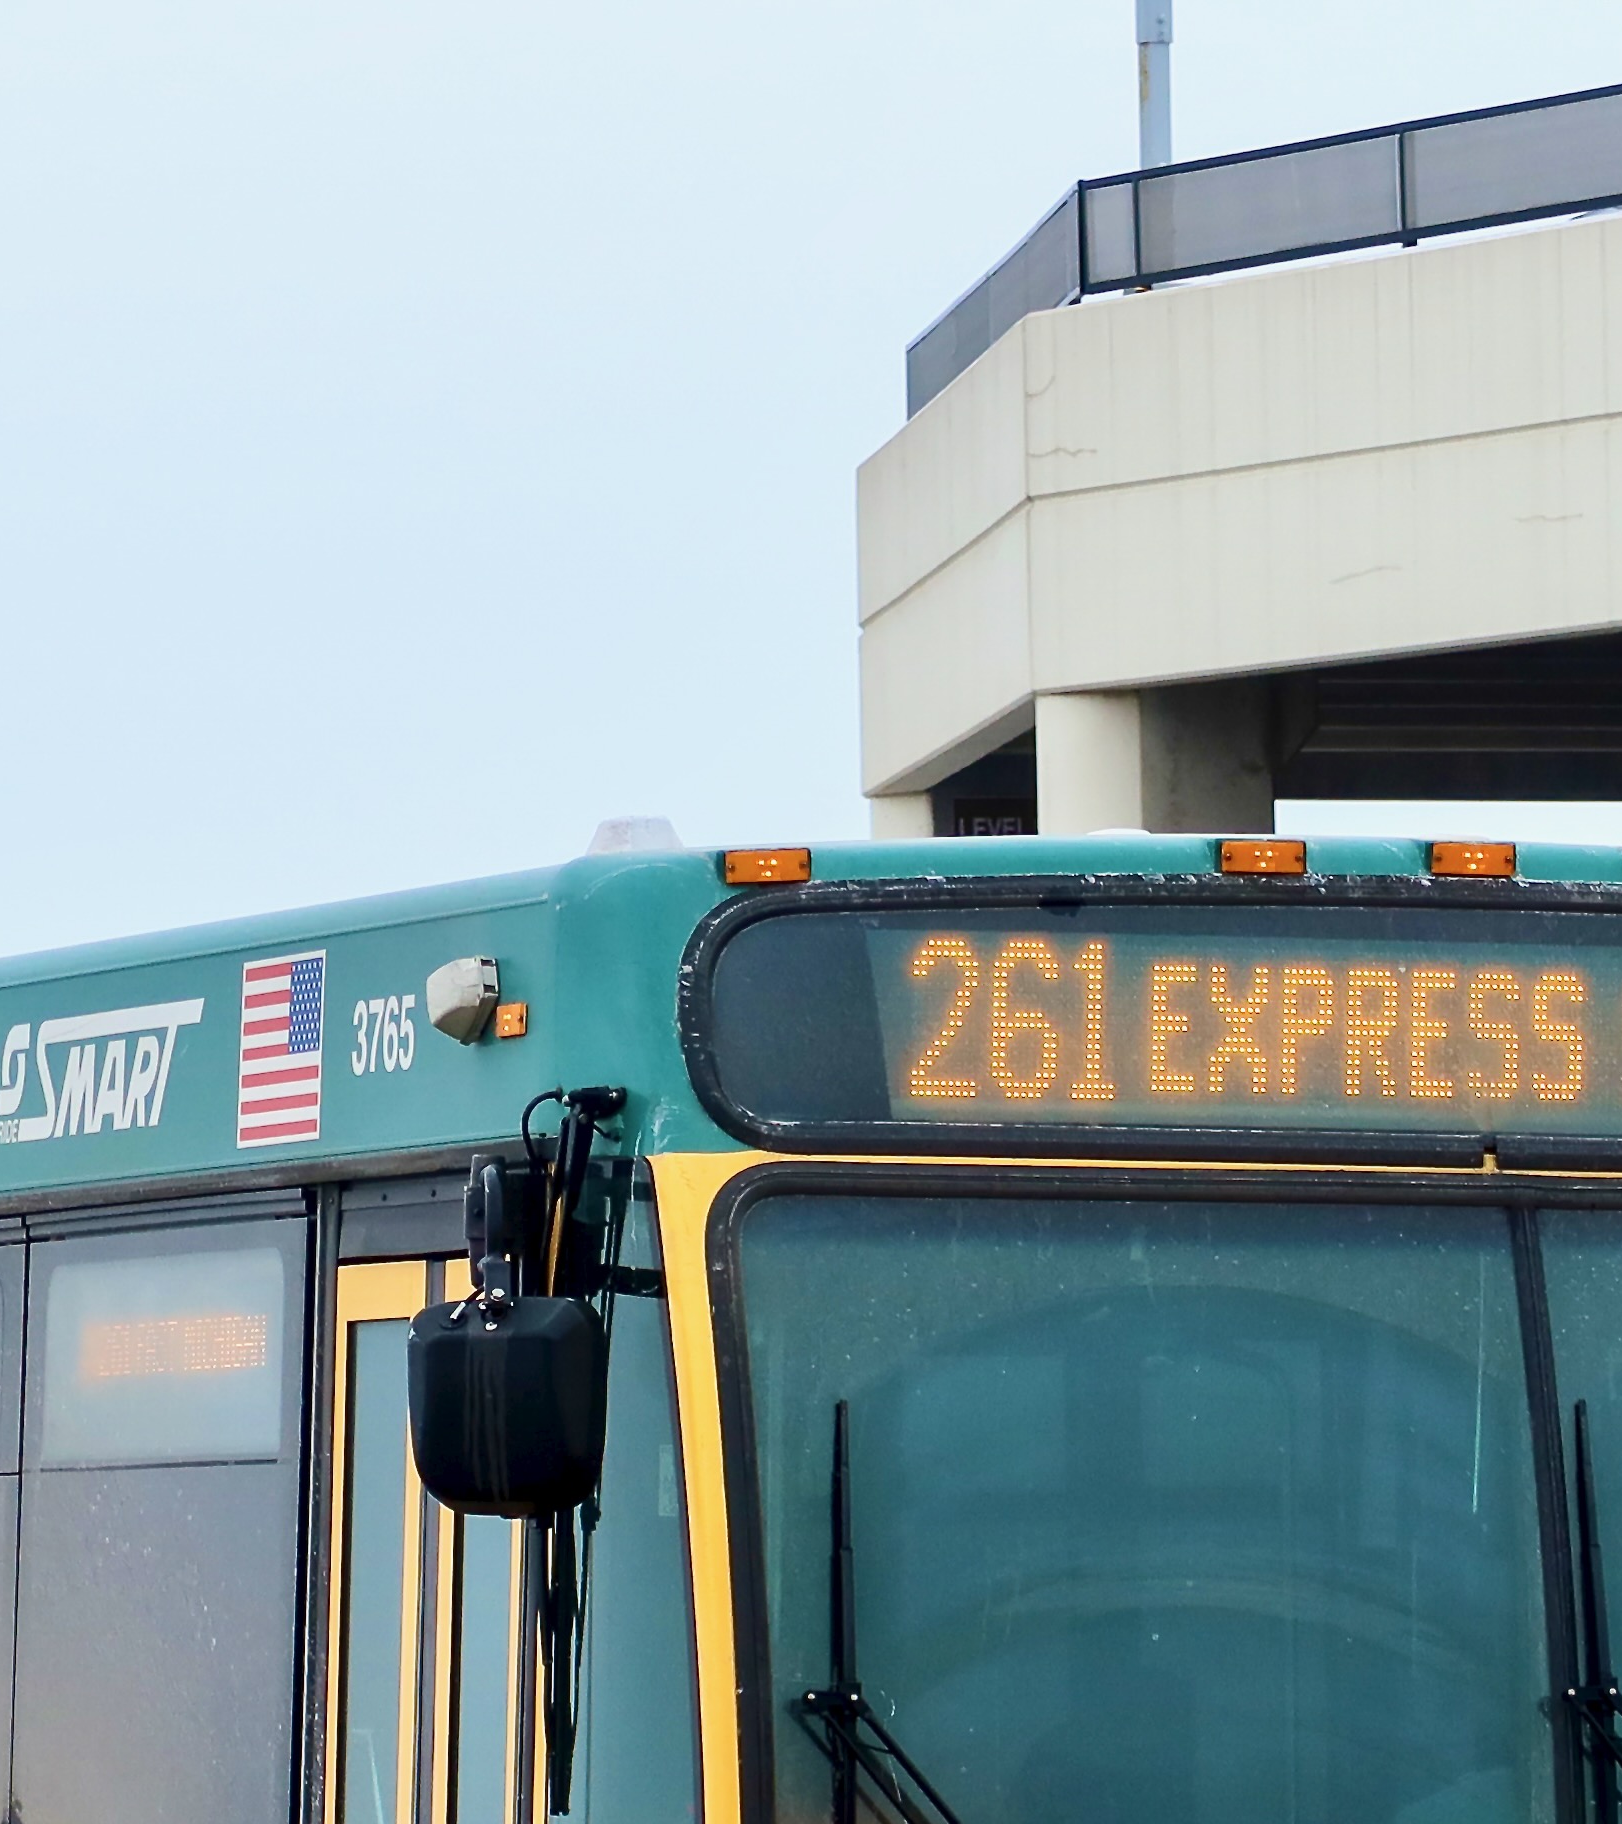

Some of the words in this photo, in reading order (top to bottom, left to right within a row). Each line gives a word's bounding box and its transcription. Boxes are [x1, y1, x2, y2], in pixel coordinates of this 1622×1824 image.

[19, 998, 205, 1143] SMART
[351, 994, 416, 1077] 3765
[910, 938, 1115, 1100] 261
[1150, 964, 1584, 1101] EXPRESS
